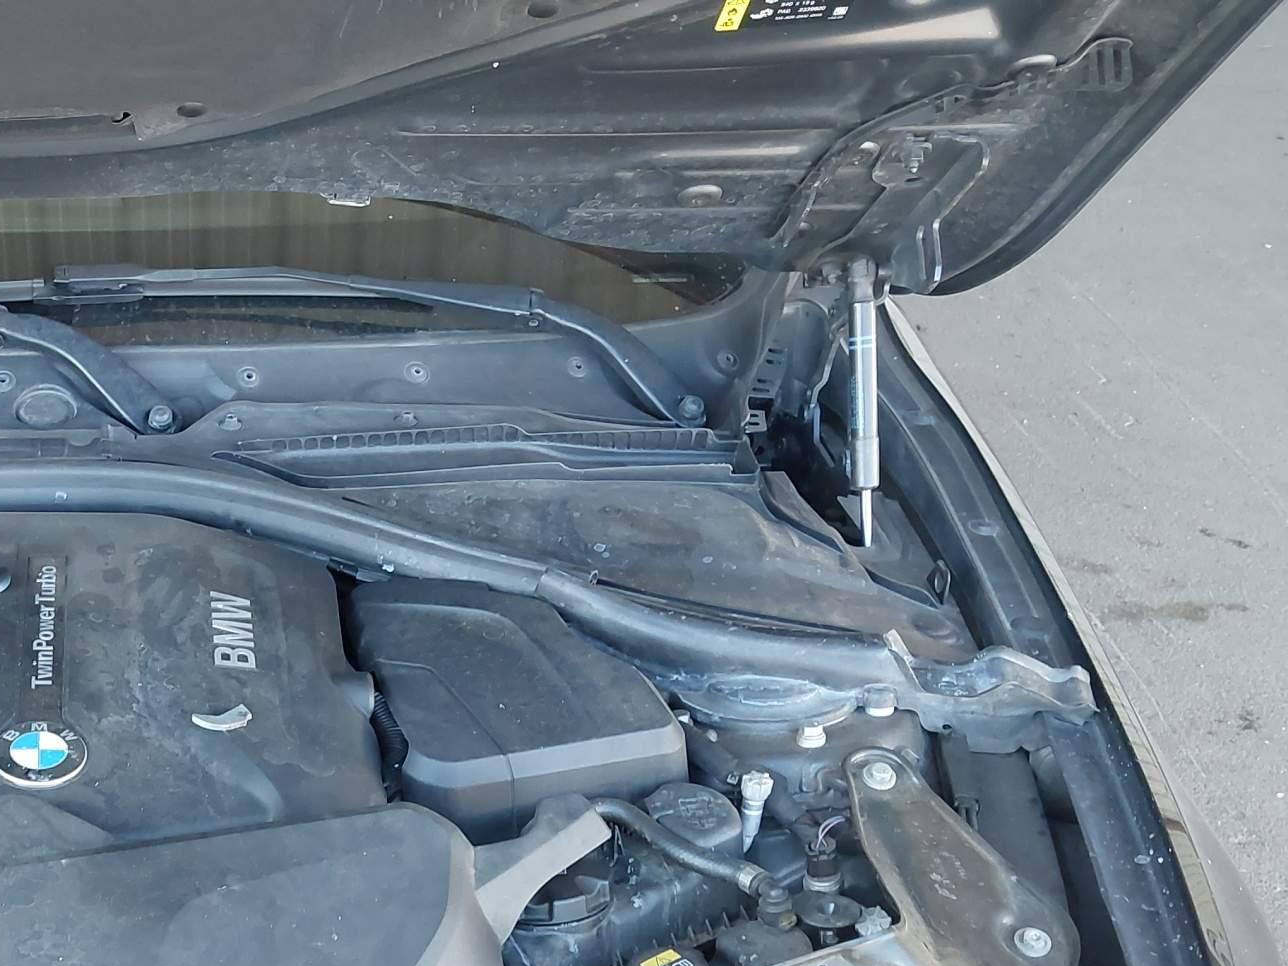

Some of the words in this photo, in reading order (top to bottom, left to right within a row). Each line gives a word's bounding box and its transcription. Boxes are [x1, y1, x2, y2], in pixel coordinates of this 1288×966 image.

[35, 565, 57, 605] Turbo
[31, 606, 56, 689] TwinPower
[210, 590, 257, 669] BMW
[3, 722, 78, 741] BMW
